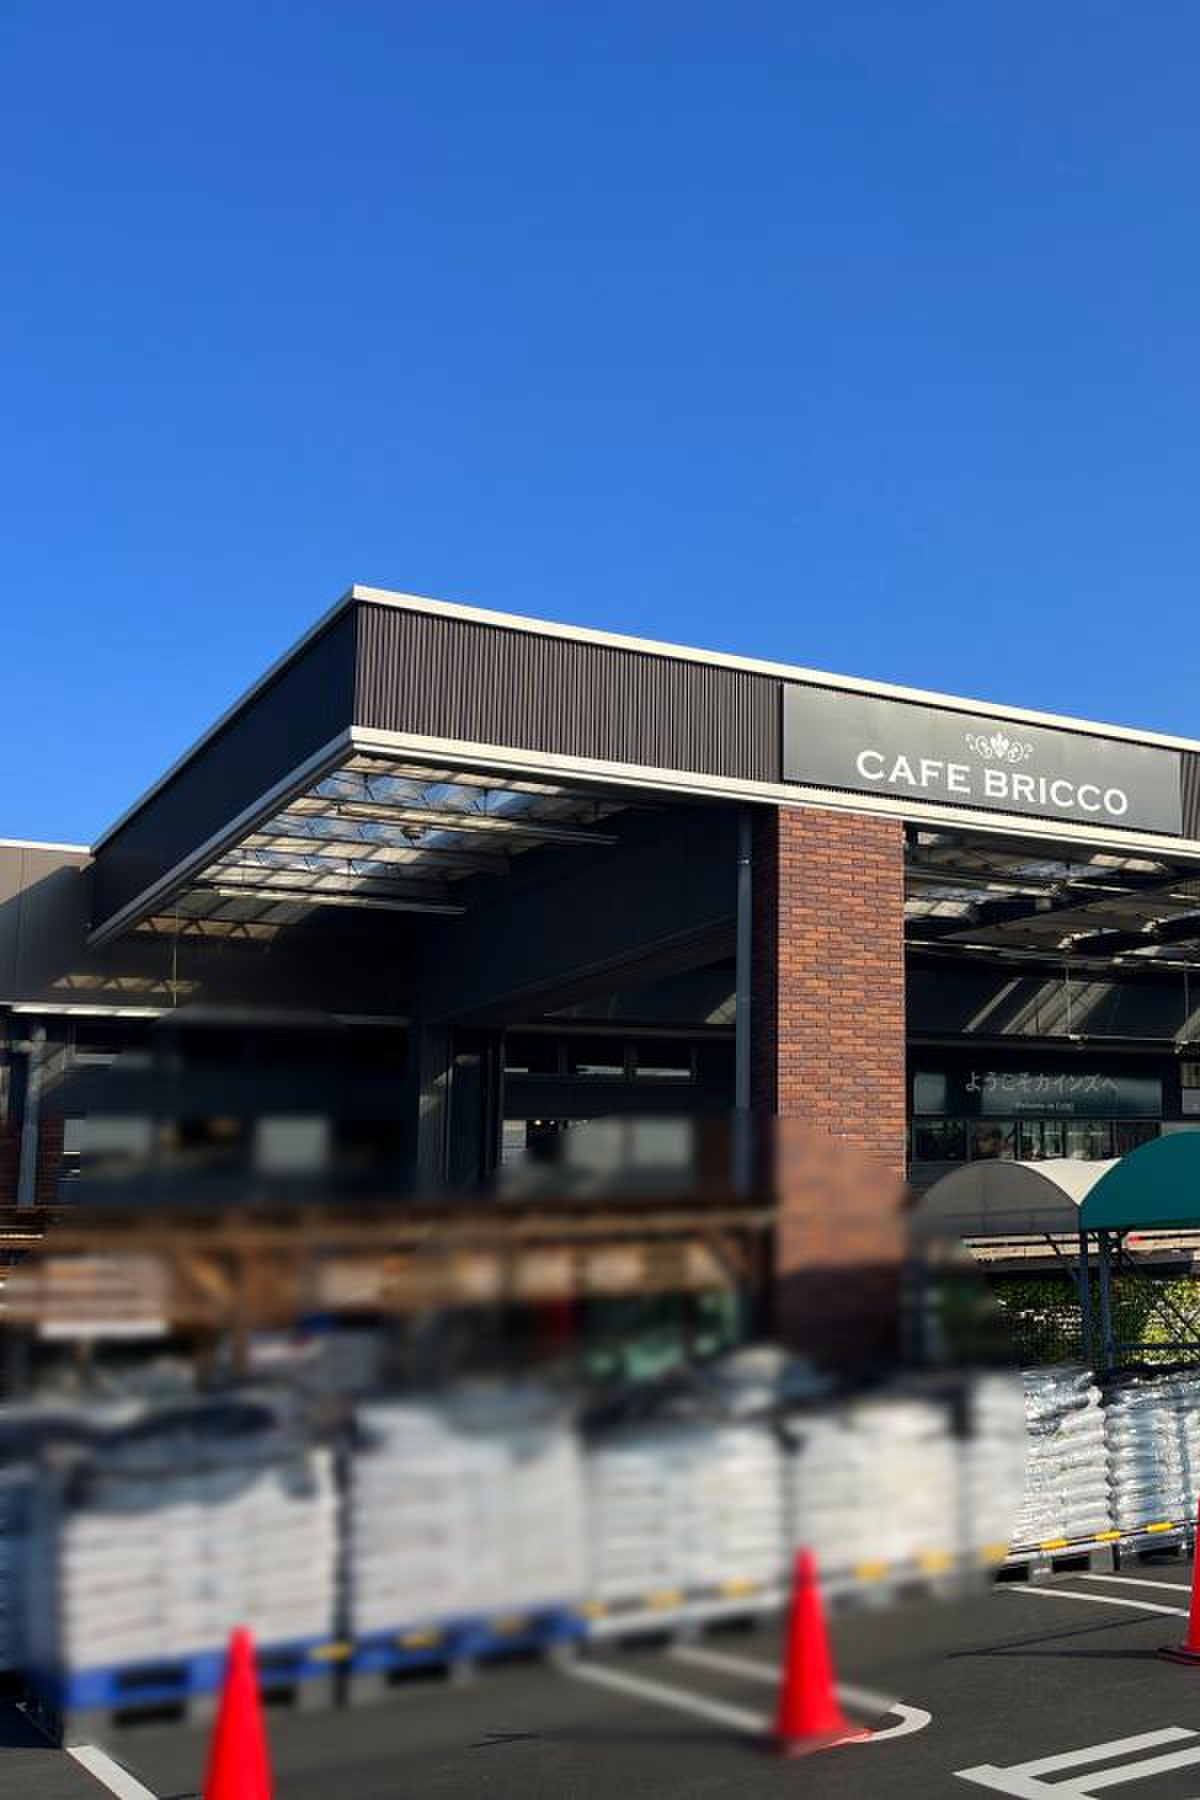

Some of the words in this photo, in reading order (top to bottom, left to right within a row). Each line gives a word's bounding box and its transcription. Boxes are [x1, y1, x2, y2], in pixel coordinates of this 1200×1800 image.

[857, 750, 971, 793] CAFE
[984, 768, 1129, 816] BRICCO
[965, 1071, 1119, 1093] ようこそカインズへ
